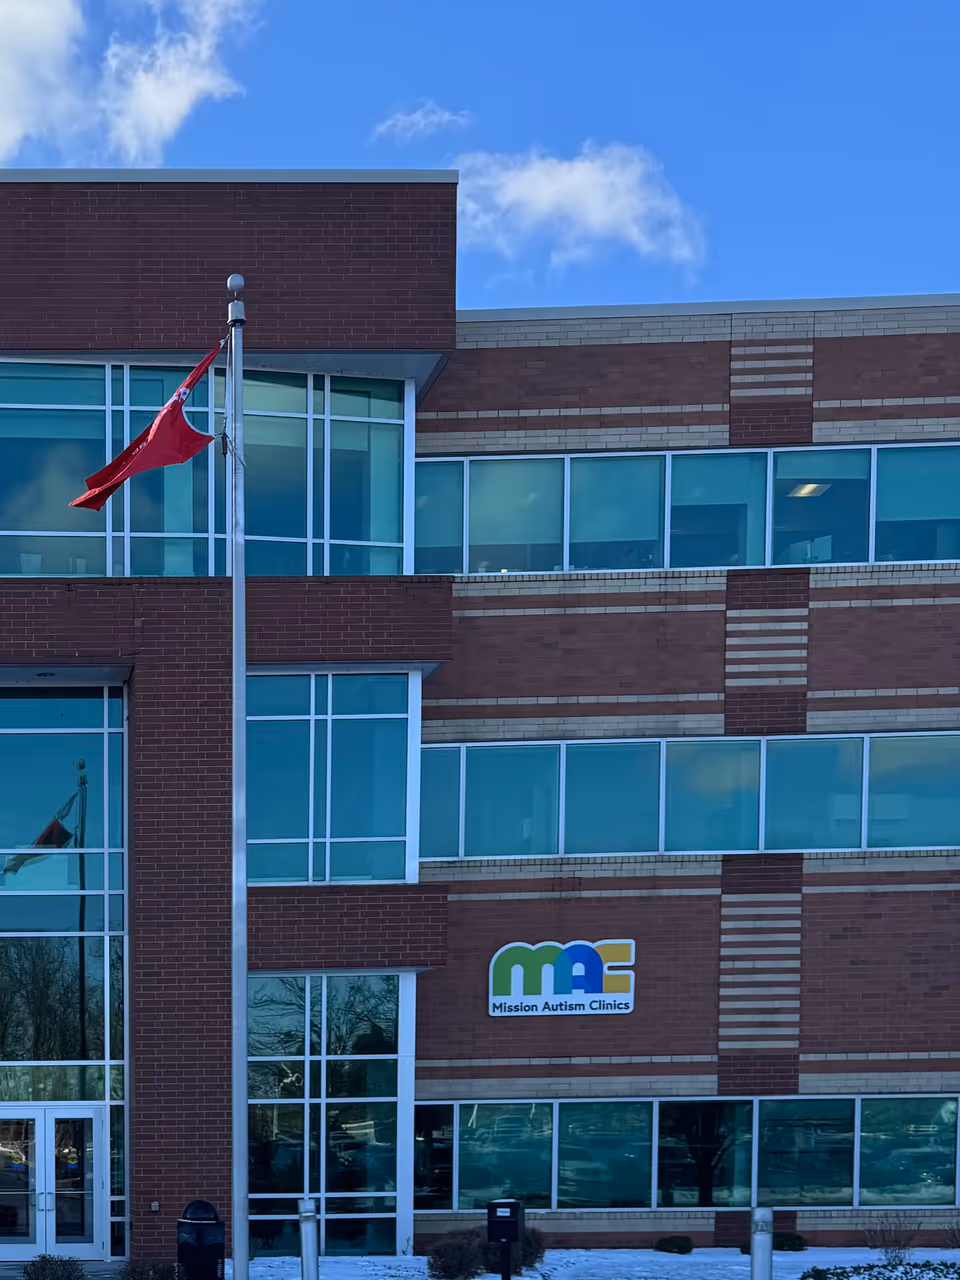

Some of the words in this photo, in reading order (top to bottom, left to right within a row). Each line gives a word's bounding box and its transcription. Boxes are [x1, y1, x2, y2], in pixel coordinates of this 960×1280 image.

[492, 1002, 538, 1013] Mission
[542, 1001, 585, 1012] Autism
[589, 999, 630, 1011] Clinics
